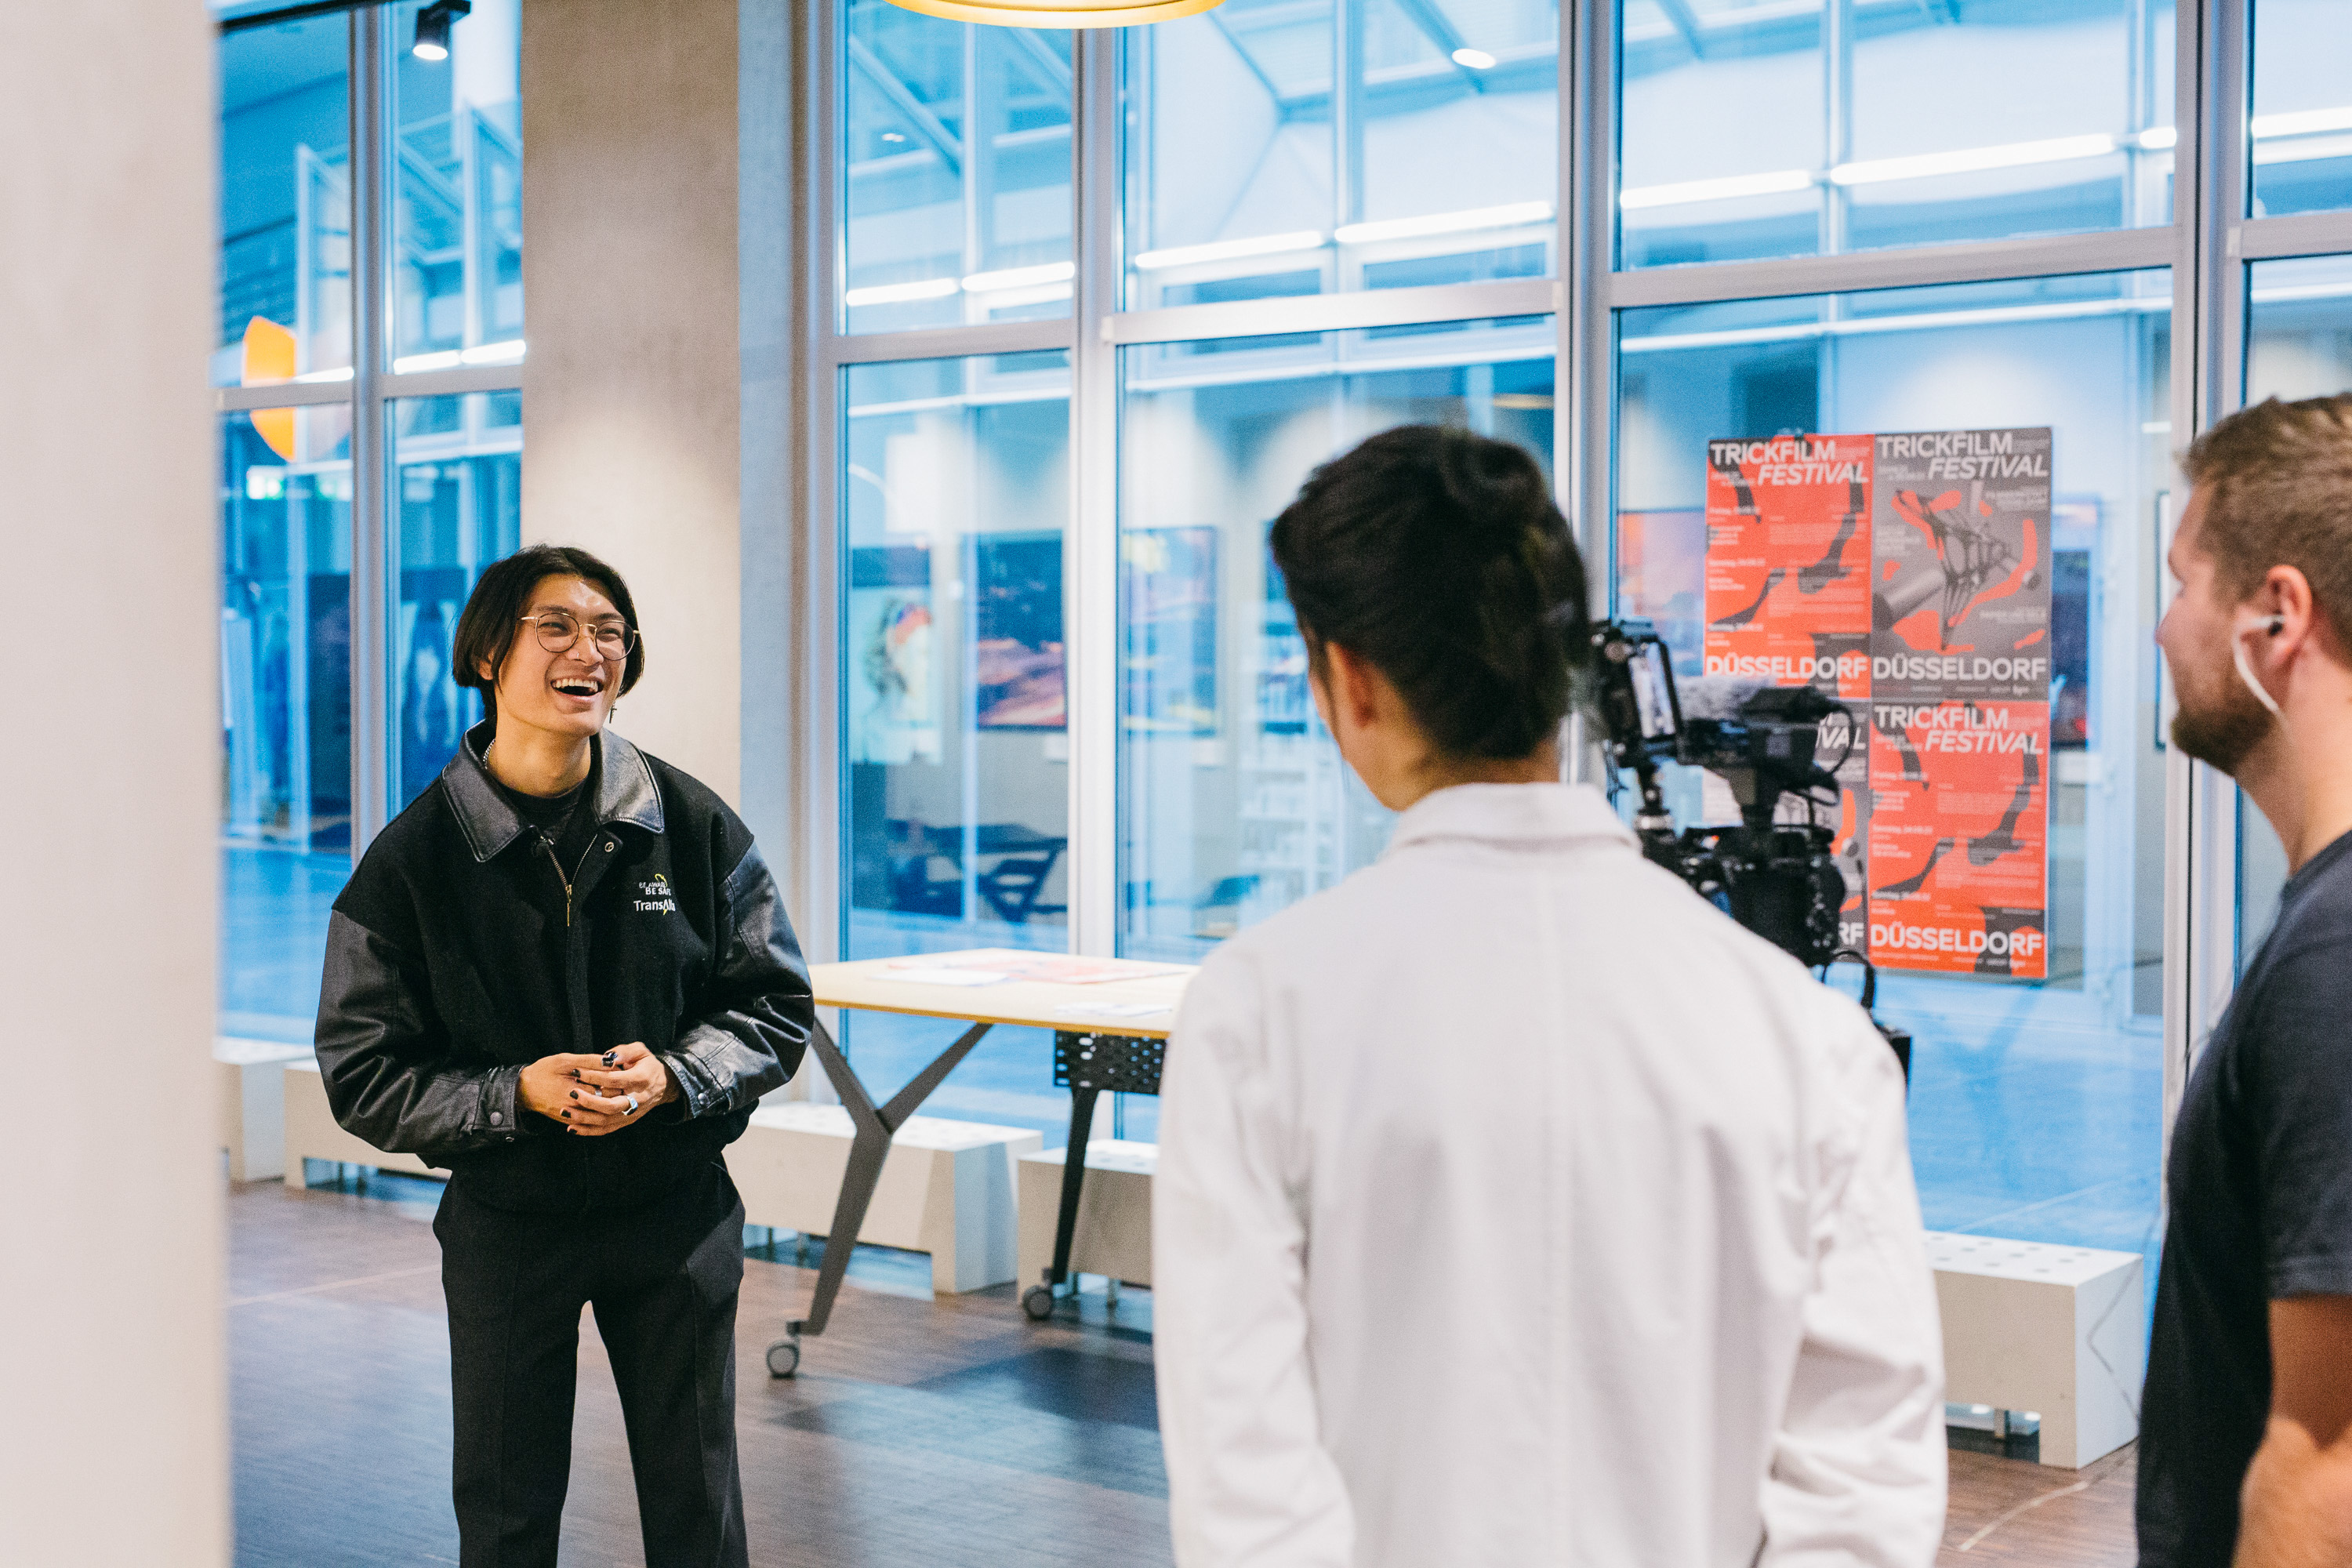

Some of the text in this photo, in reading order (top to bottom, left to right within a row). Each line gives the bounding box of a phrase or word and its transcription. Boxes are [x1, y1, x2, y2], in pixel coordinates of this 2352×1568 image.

[1710, 440, 1836, 466] TRICKFILM
[1878, 431, 2013, 459] TRICKFILM
[1758, 462, 1868, 486] FESTIVAL
[1928, 454, 2049, 480] FESTIVAL
[1707, 652, 1867, 679] DÜSSELDORF
[1872, 653, 2046, 681] DÜSSELDORF
[1874, 706, 2009, 730] TRICKFILM
[1815, 726, 1867, 750] IVAL
[1925, 729, 2043, 755] FESTIVAL
[1871, 922, 2042, 956] DÜSSELDORF
